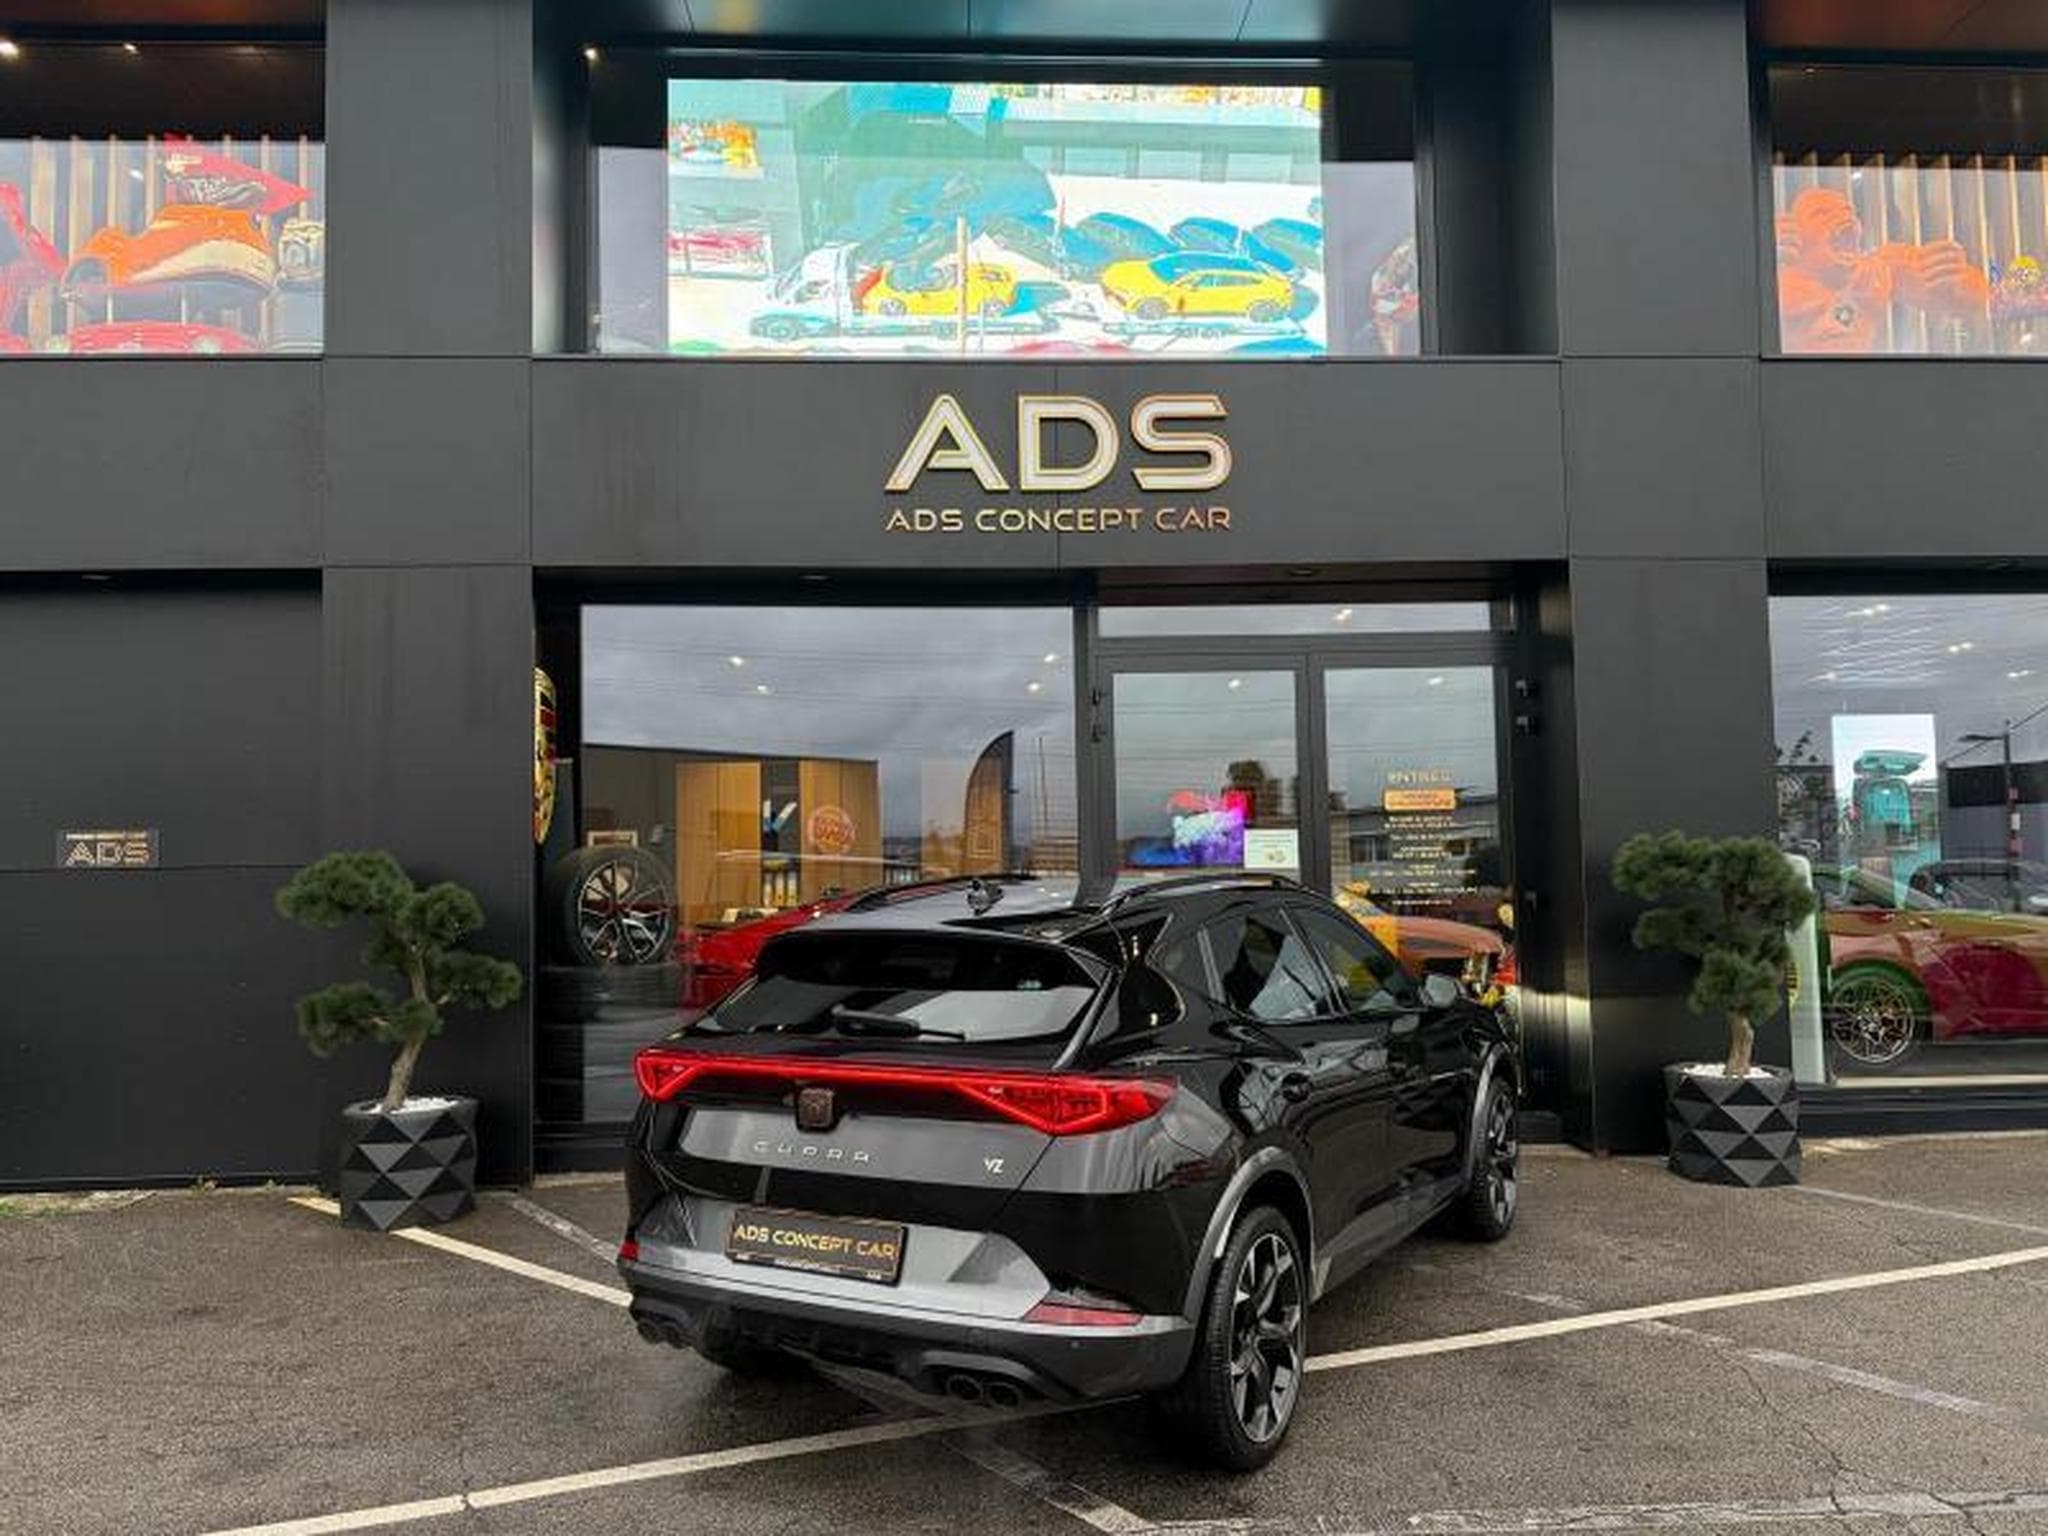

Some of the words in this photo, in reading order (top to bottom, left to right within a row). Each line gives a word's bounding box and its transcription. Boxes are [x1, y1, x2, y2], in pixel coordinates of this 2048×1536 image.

[884, 393, 1233, 491] ADS
[885, 509, 963, 532] ADS
[975, 508, 1143, 533] CONCEPT
[1155, 507, 1231, 531] CAR
[66, 841, 150, 866] ADS
[753, 1140, 870, 1162] CUPRA
[983, 1158, 1004, 1174] VZ
[734, 1224, 768, 1244] ADS
[773, 1229, 853, 1253] CONCEPT
[856, 1240, 894, 1260] CAR
